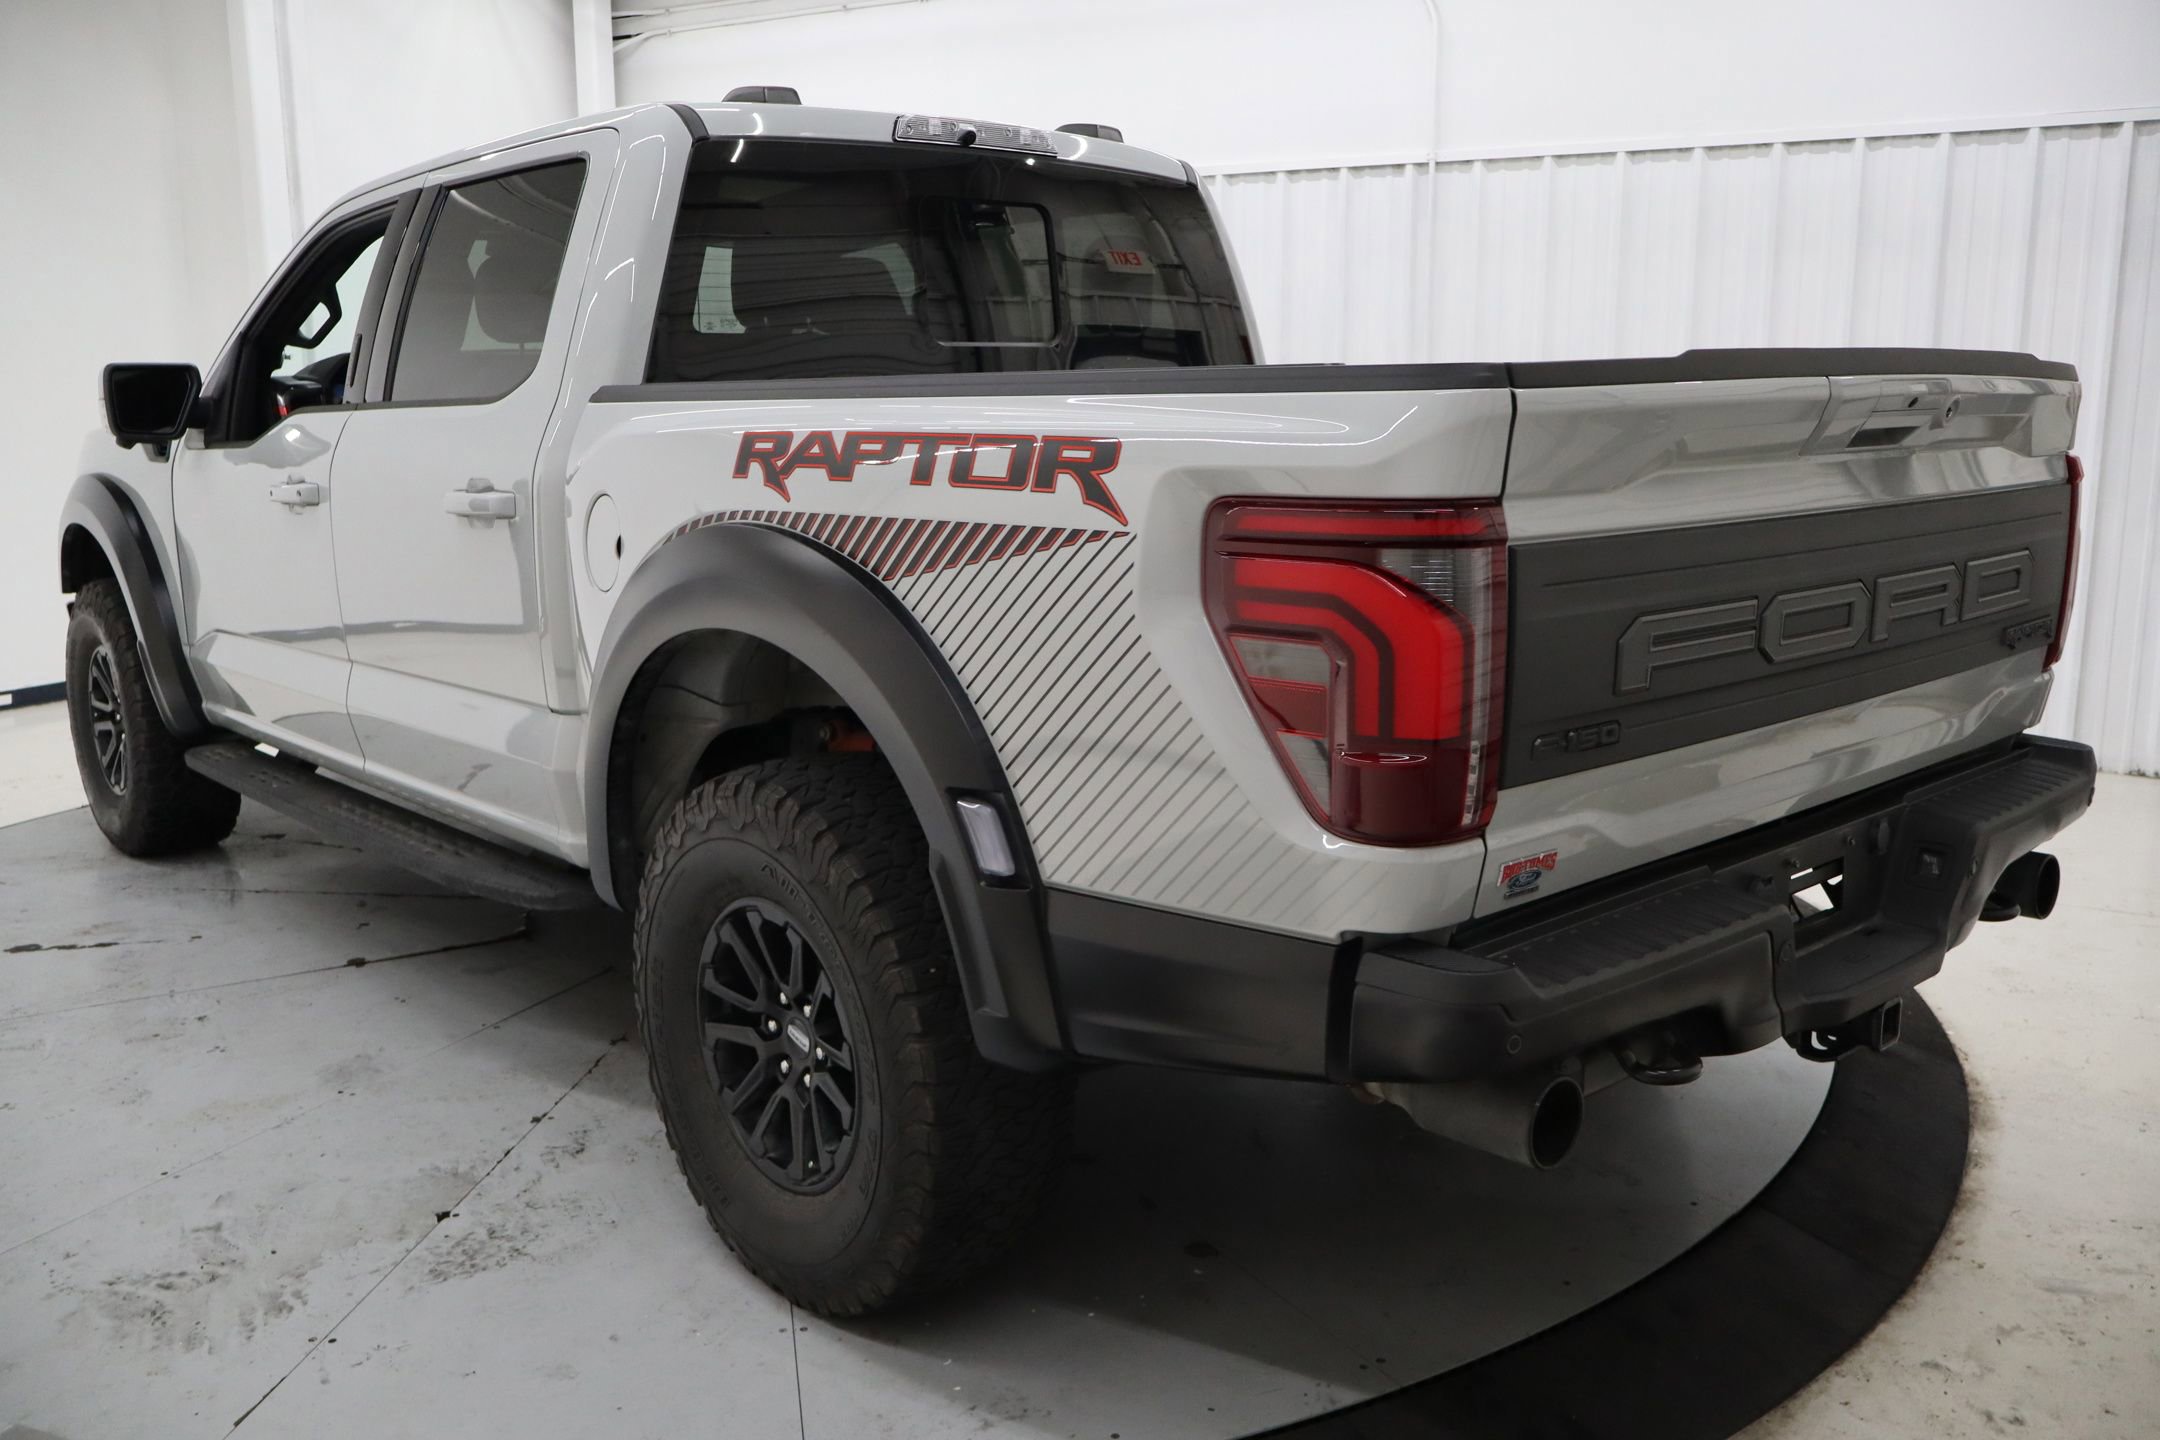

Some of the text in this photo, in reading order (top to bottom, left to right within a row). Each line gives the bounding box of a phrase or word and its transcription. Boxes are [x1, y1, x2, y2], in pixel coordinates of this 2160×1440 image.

[732, 431, 1129, 527] RAPTOR
[1616, 549, 2033, 694] FORD
[1531, 720, 1621, 760] F-150
